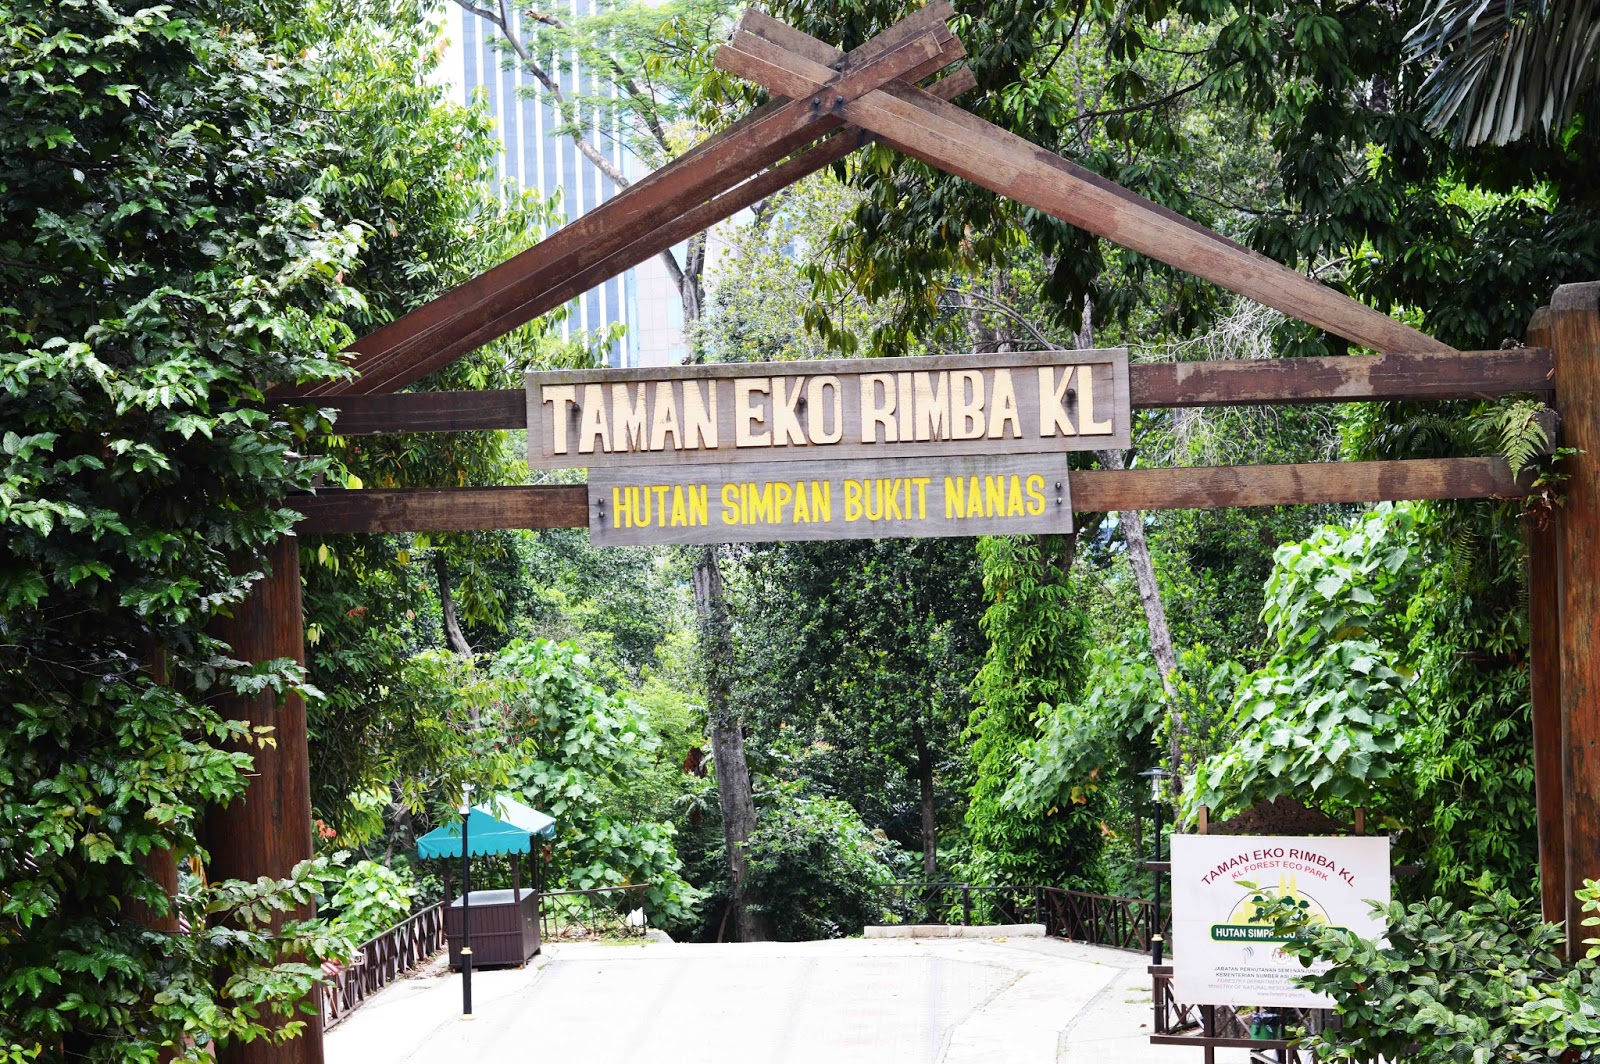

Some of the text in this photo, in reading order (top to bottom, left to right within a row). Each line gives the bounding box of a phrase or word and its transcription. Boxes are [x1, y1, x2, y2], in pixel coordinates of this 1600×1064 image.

[542, 364, 1113, 454] TAMAN EKO RIMBA KL
[612, 474, 1047, 528] HUTAN SIMPAN BUKIT NANAS
[1201, 847, 1358, 887] TAMAN EKO RIMBA KL
[1231, 861, 1329, 881] KL FOREST ECO PARK
[1216, 928, 1247, 938] HUTAN
[1248, 928, 1282, 939] SIMPA
